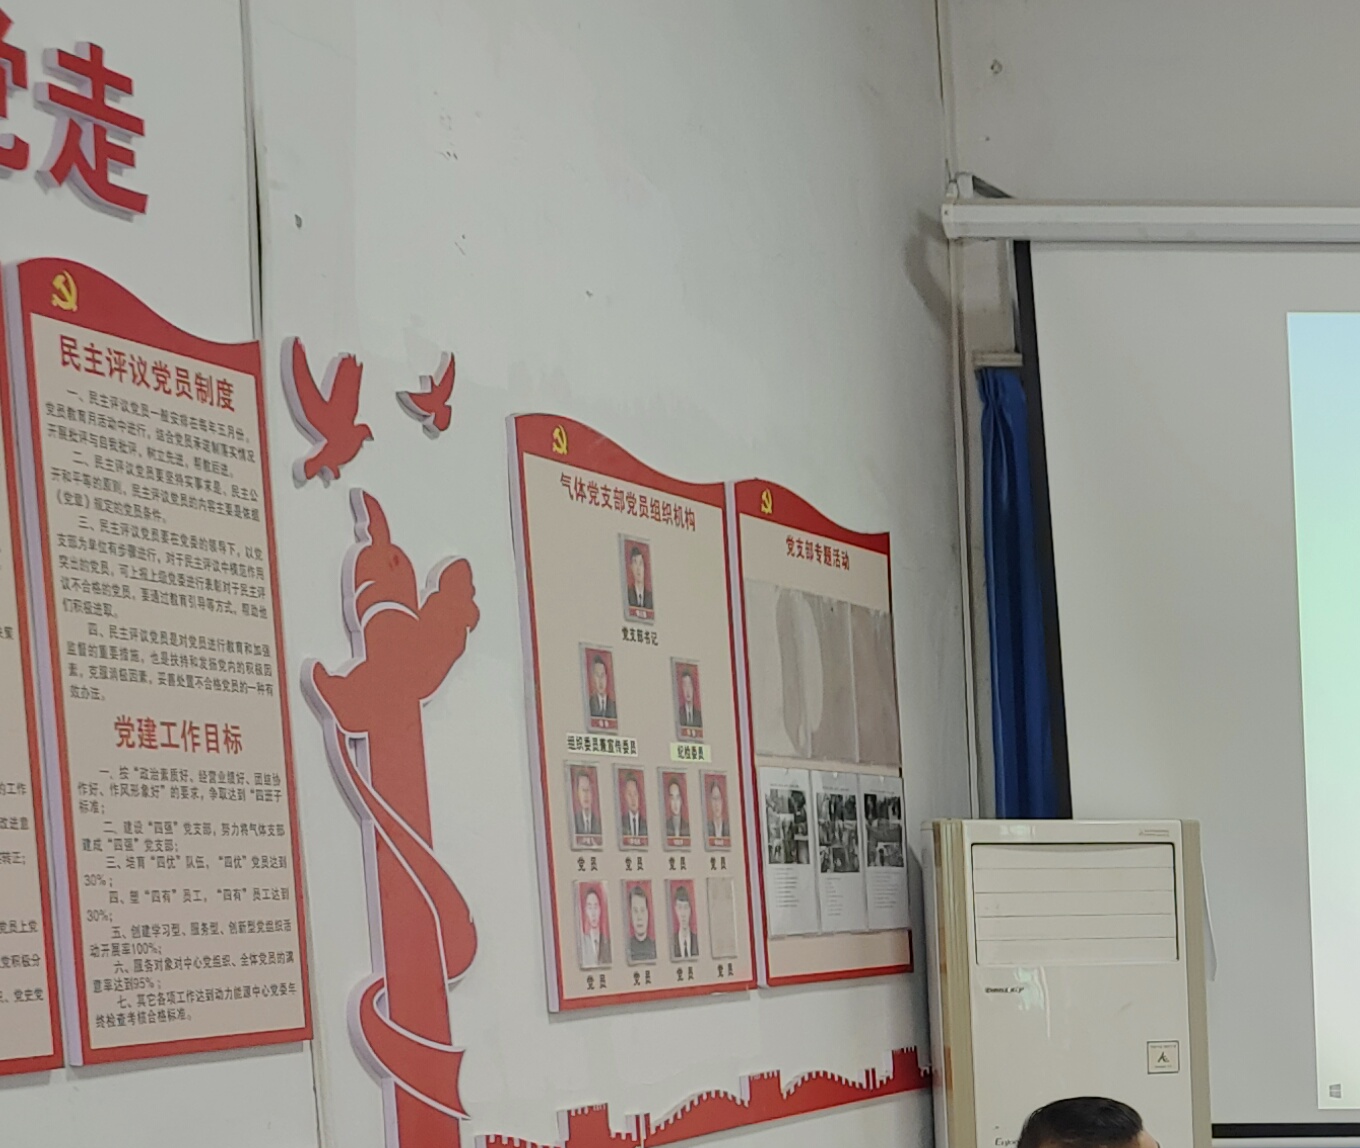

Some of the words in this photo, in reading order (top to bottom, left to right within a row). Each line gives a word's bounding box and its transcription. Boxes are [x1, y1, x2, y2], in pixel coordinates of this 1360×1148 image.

[0, 5, 148, 214] 走
[59, 334, 235, 413] 民主评议党员制度
[559, 471, 696, 532] 气体党支部党员组织机构
[785, 535, 850, 571] 党支部专题活动
[621, 625, 659, 646] 党支部书记
[114, 714, 243, 755] 党建工作目标
